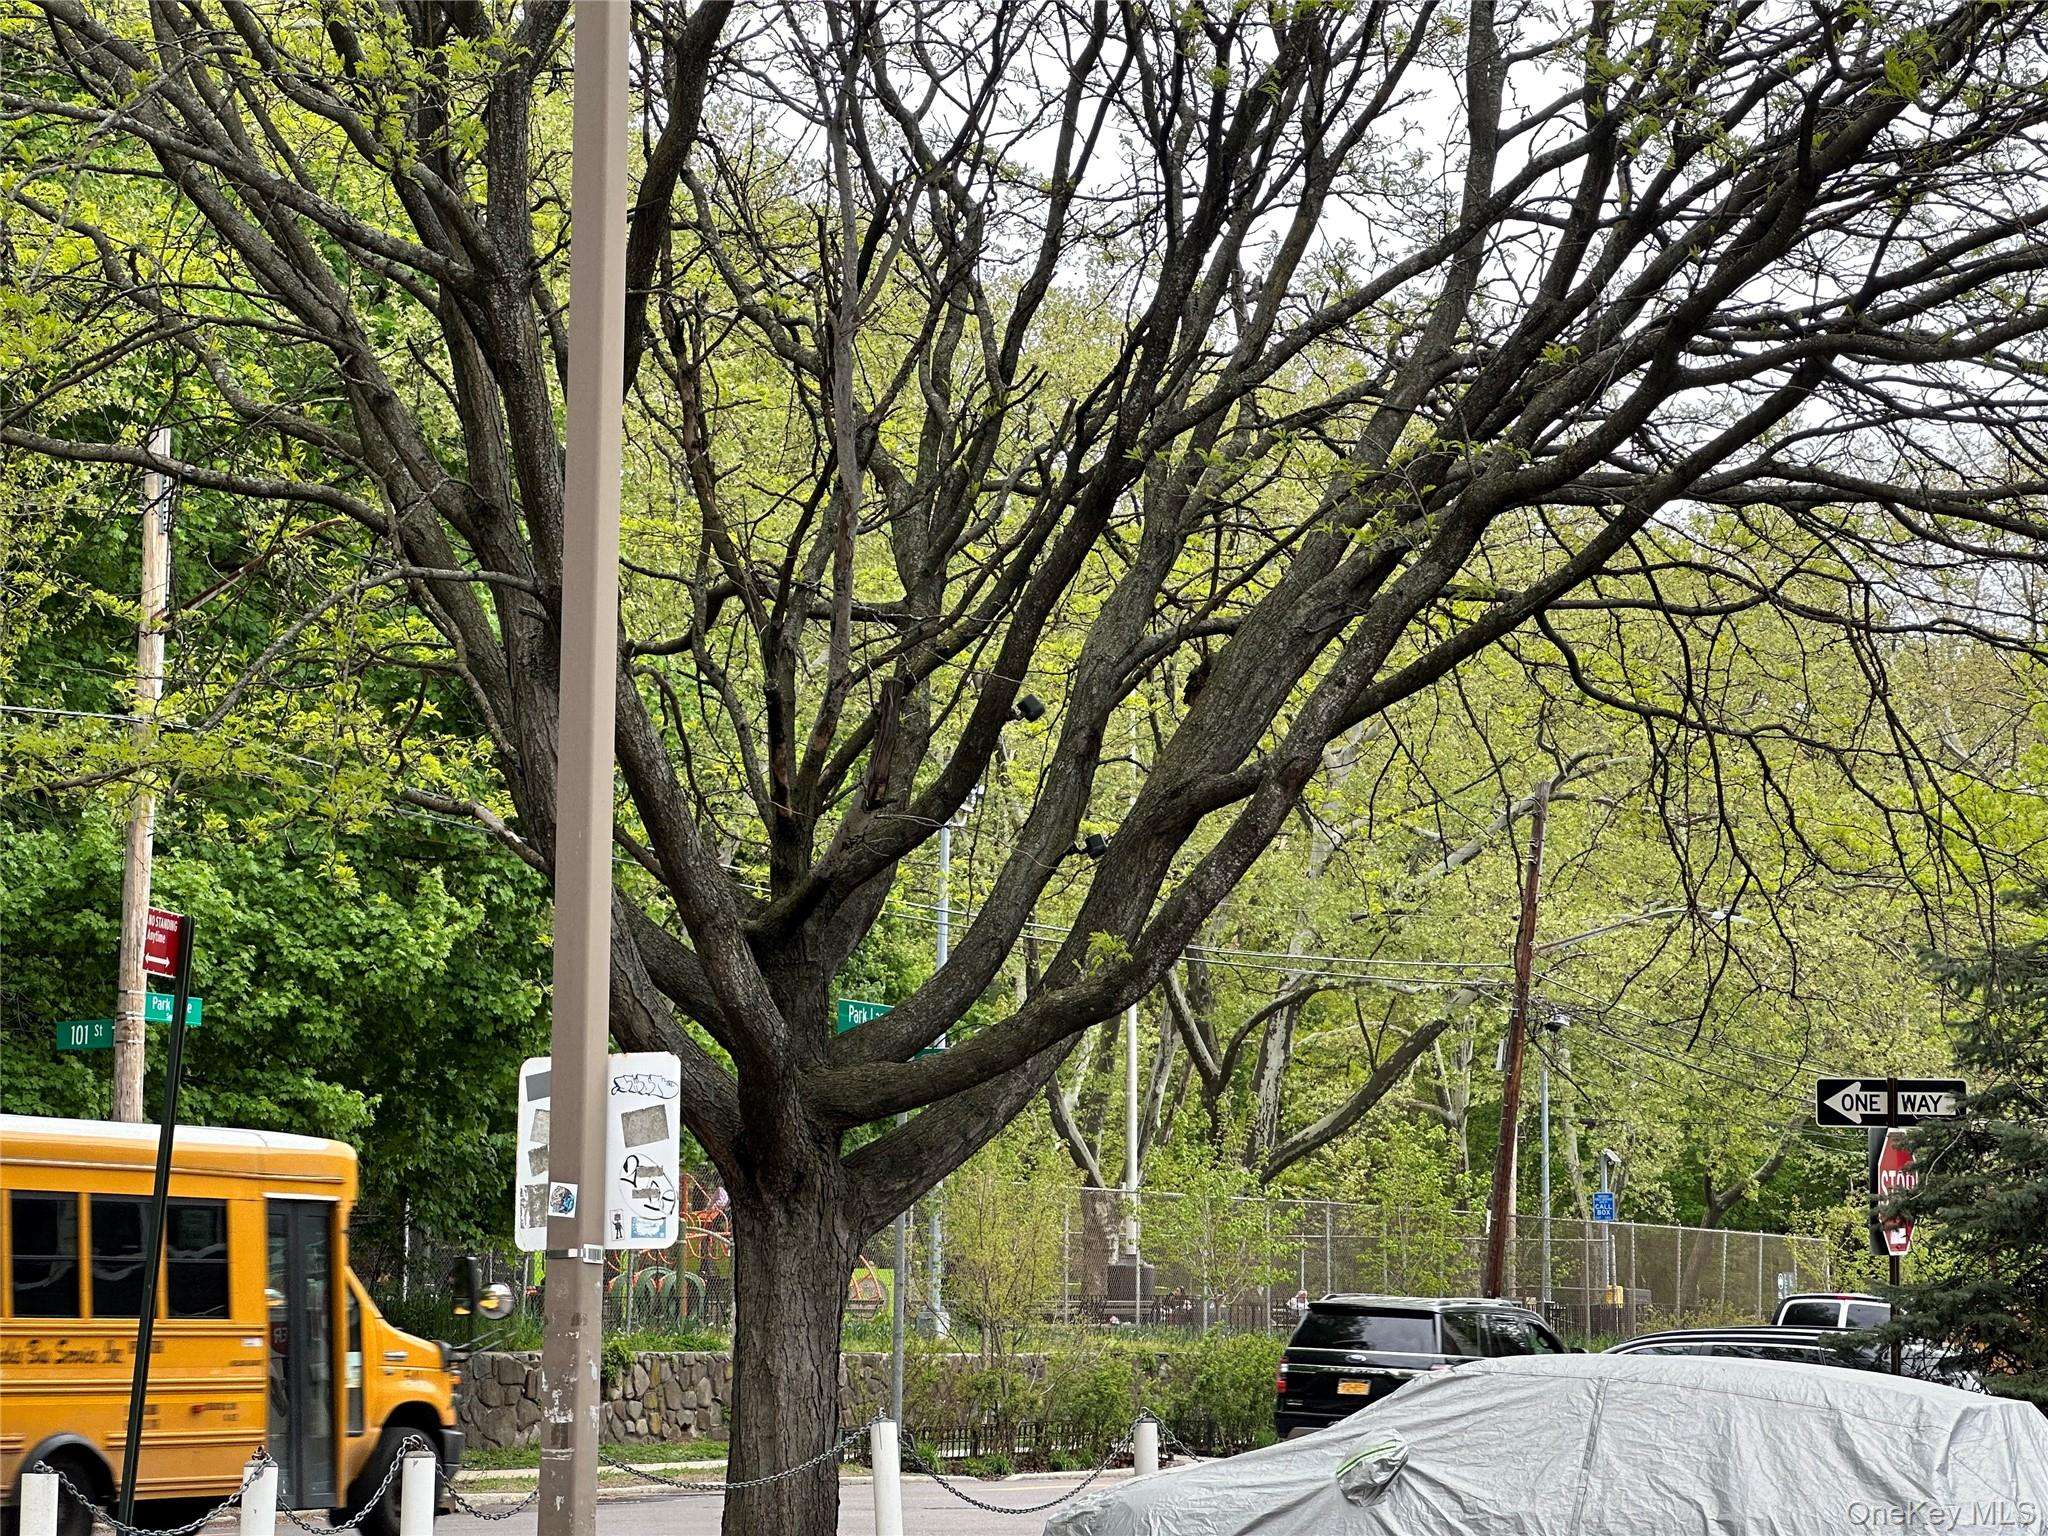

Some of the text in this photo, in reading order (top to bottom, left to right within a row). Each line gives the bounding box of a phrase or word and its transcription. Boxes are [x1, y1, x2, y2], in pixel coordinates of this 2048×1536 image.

[149, 914, 178, 932] NO STANDING
[147, 929, 167, 944] Anytime
[152, 996, 171, 1012] Park
[848, 1004, 868, 1024] Park
[71, 1024, 103, 1045] 101 St
[1841, 1093, 1943, 1113] ONE WAY
